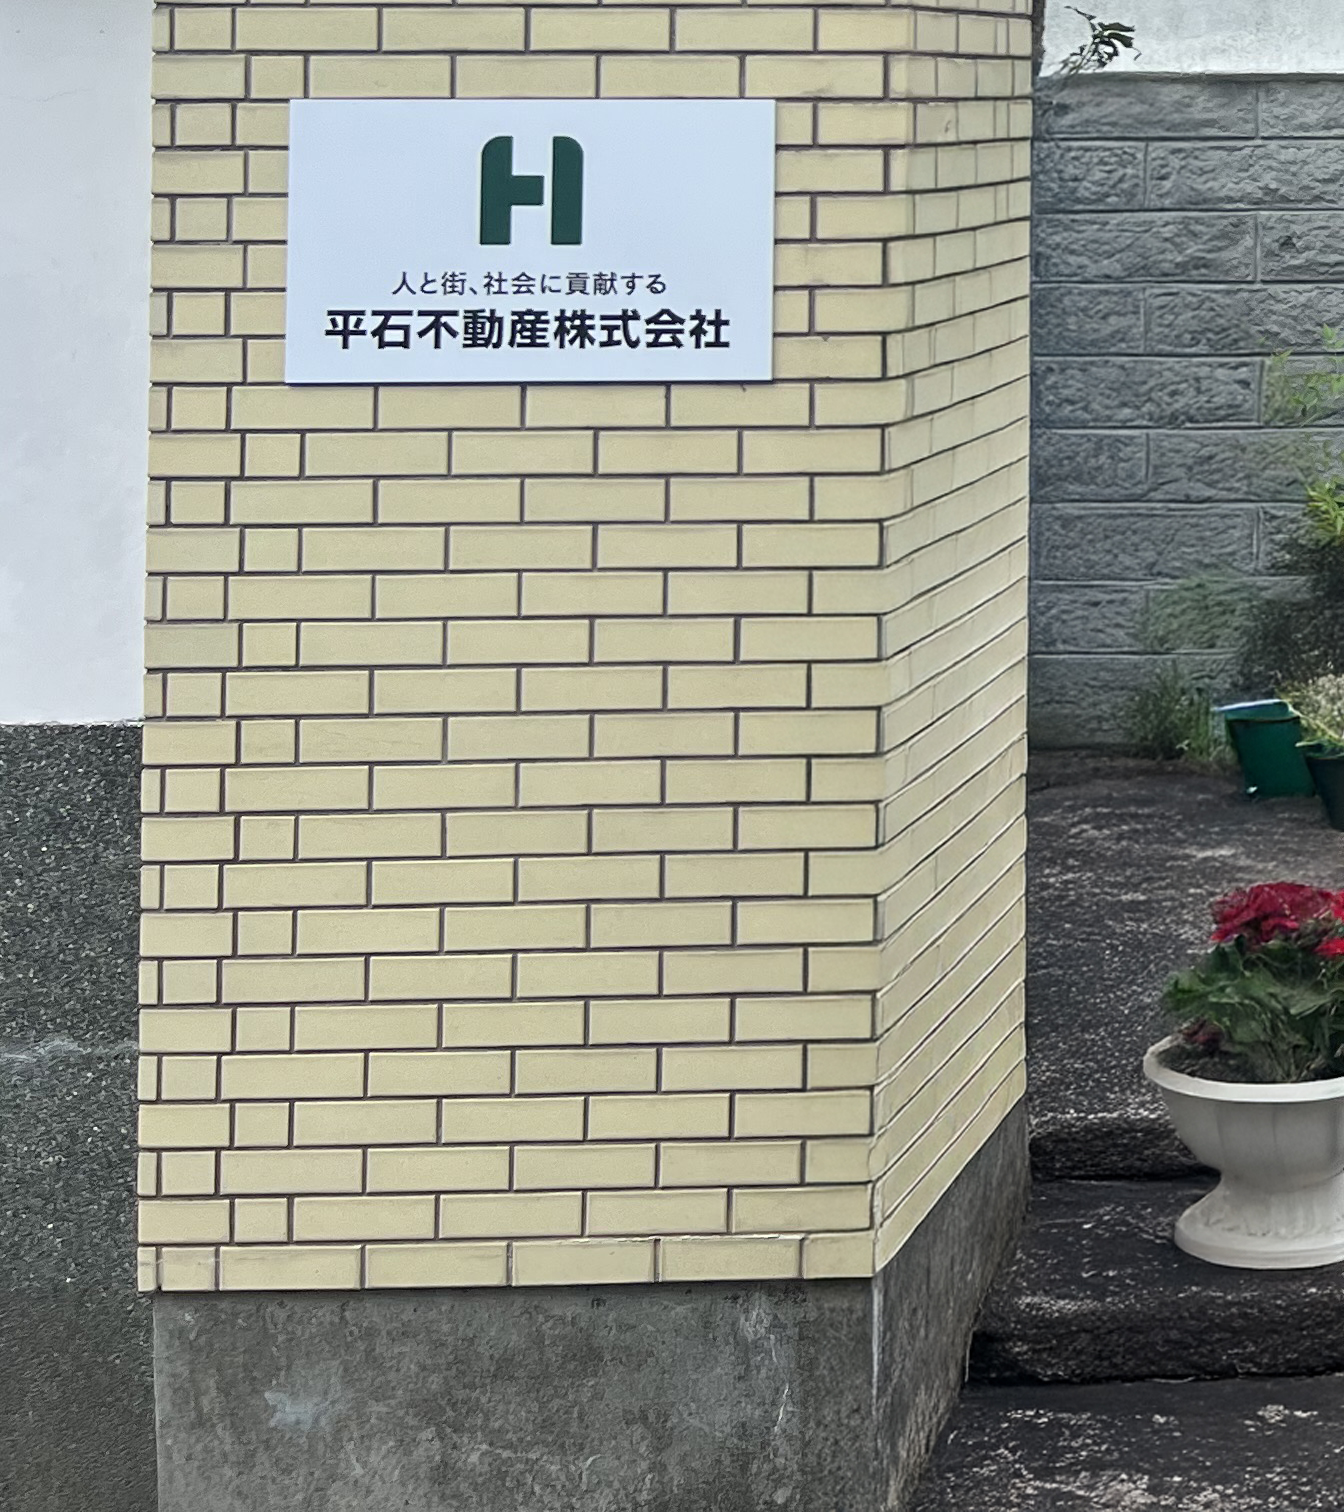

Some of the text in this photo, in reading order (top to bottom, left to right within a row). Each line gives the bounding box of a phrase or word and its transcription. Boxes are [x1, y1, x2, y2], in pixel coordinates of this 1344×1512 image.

[391, 270, 668, 296] 人と街、社会に貢献する
[324, 307, 732, 351] 平石不動産株式会社
